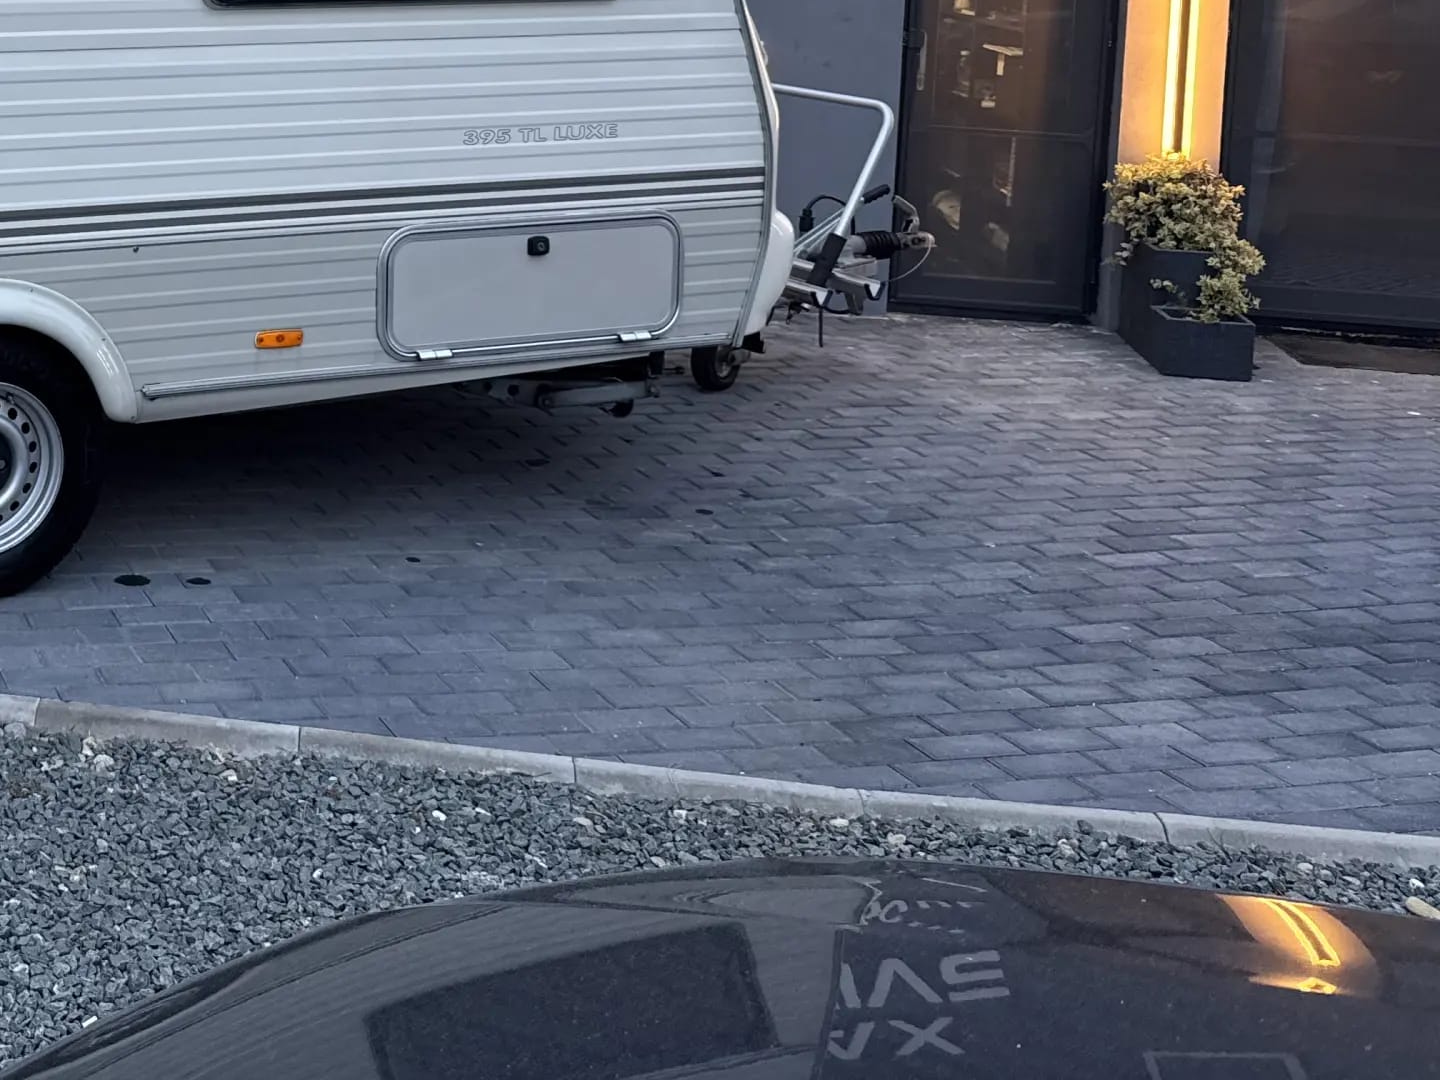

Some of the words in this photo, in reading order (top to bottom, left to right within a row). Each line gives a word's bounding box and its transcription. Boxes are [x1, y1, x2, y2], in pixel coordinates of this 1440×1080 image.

[462, 128, 512, 146] 395
[517, 127, 547, 143] TL
[553, 123, 619, 142] LUXE
